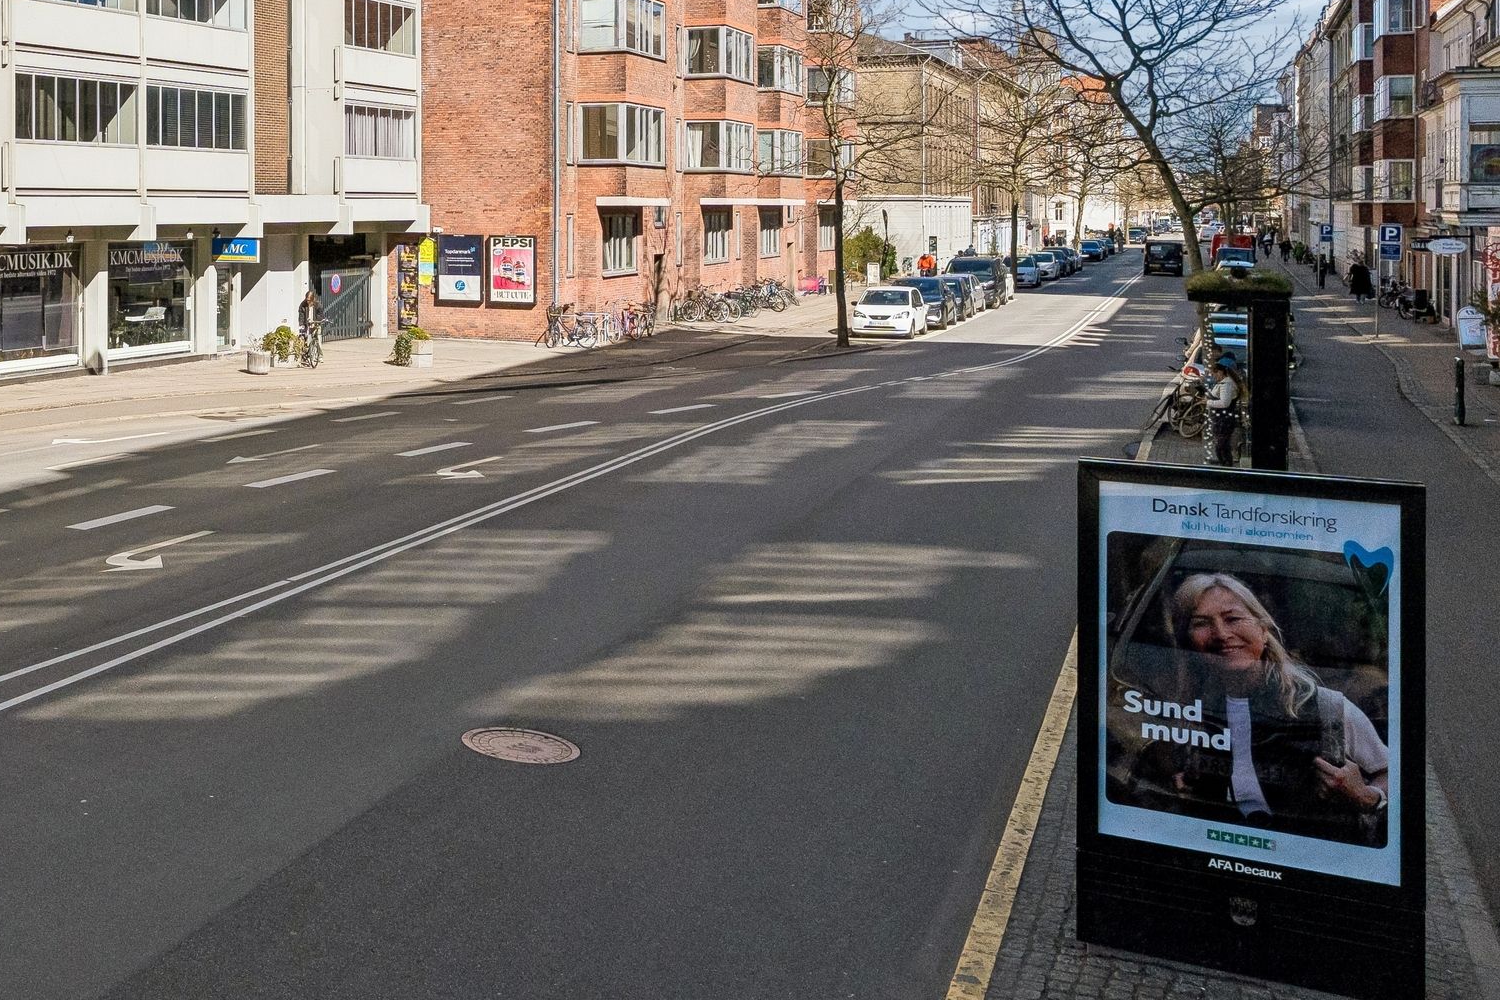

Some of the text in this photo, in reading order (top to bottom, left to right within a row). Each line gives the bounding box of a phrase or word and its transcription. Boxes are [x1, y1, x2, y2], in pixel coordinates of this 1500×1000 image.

[1385, 227, 1397, 240] P
[222, 243, 248, 254] KMC
[493, 239, 532, 248] PEPSI
[110, 249, 183, 265] KMCMUSIK.DK
[1152, 498, 1337, 532] Dansk Tandforsikring
[1245, 526, 1314, 541] økonomien
[1123, 690, 1203, 724] Sund
[1141, 719, 1232, 752] mund
[1208, 858, 1283, 880] AFA Decaux
